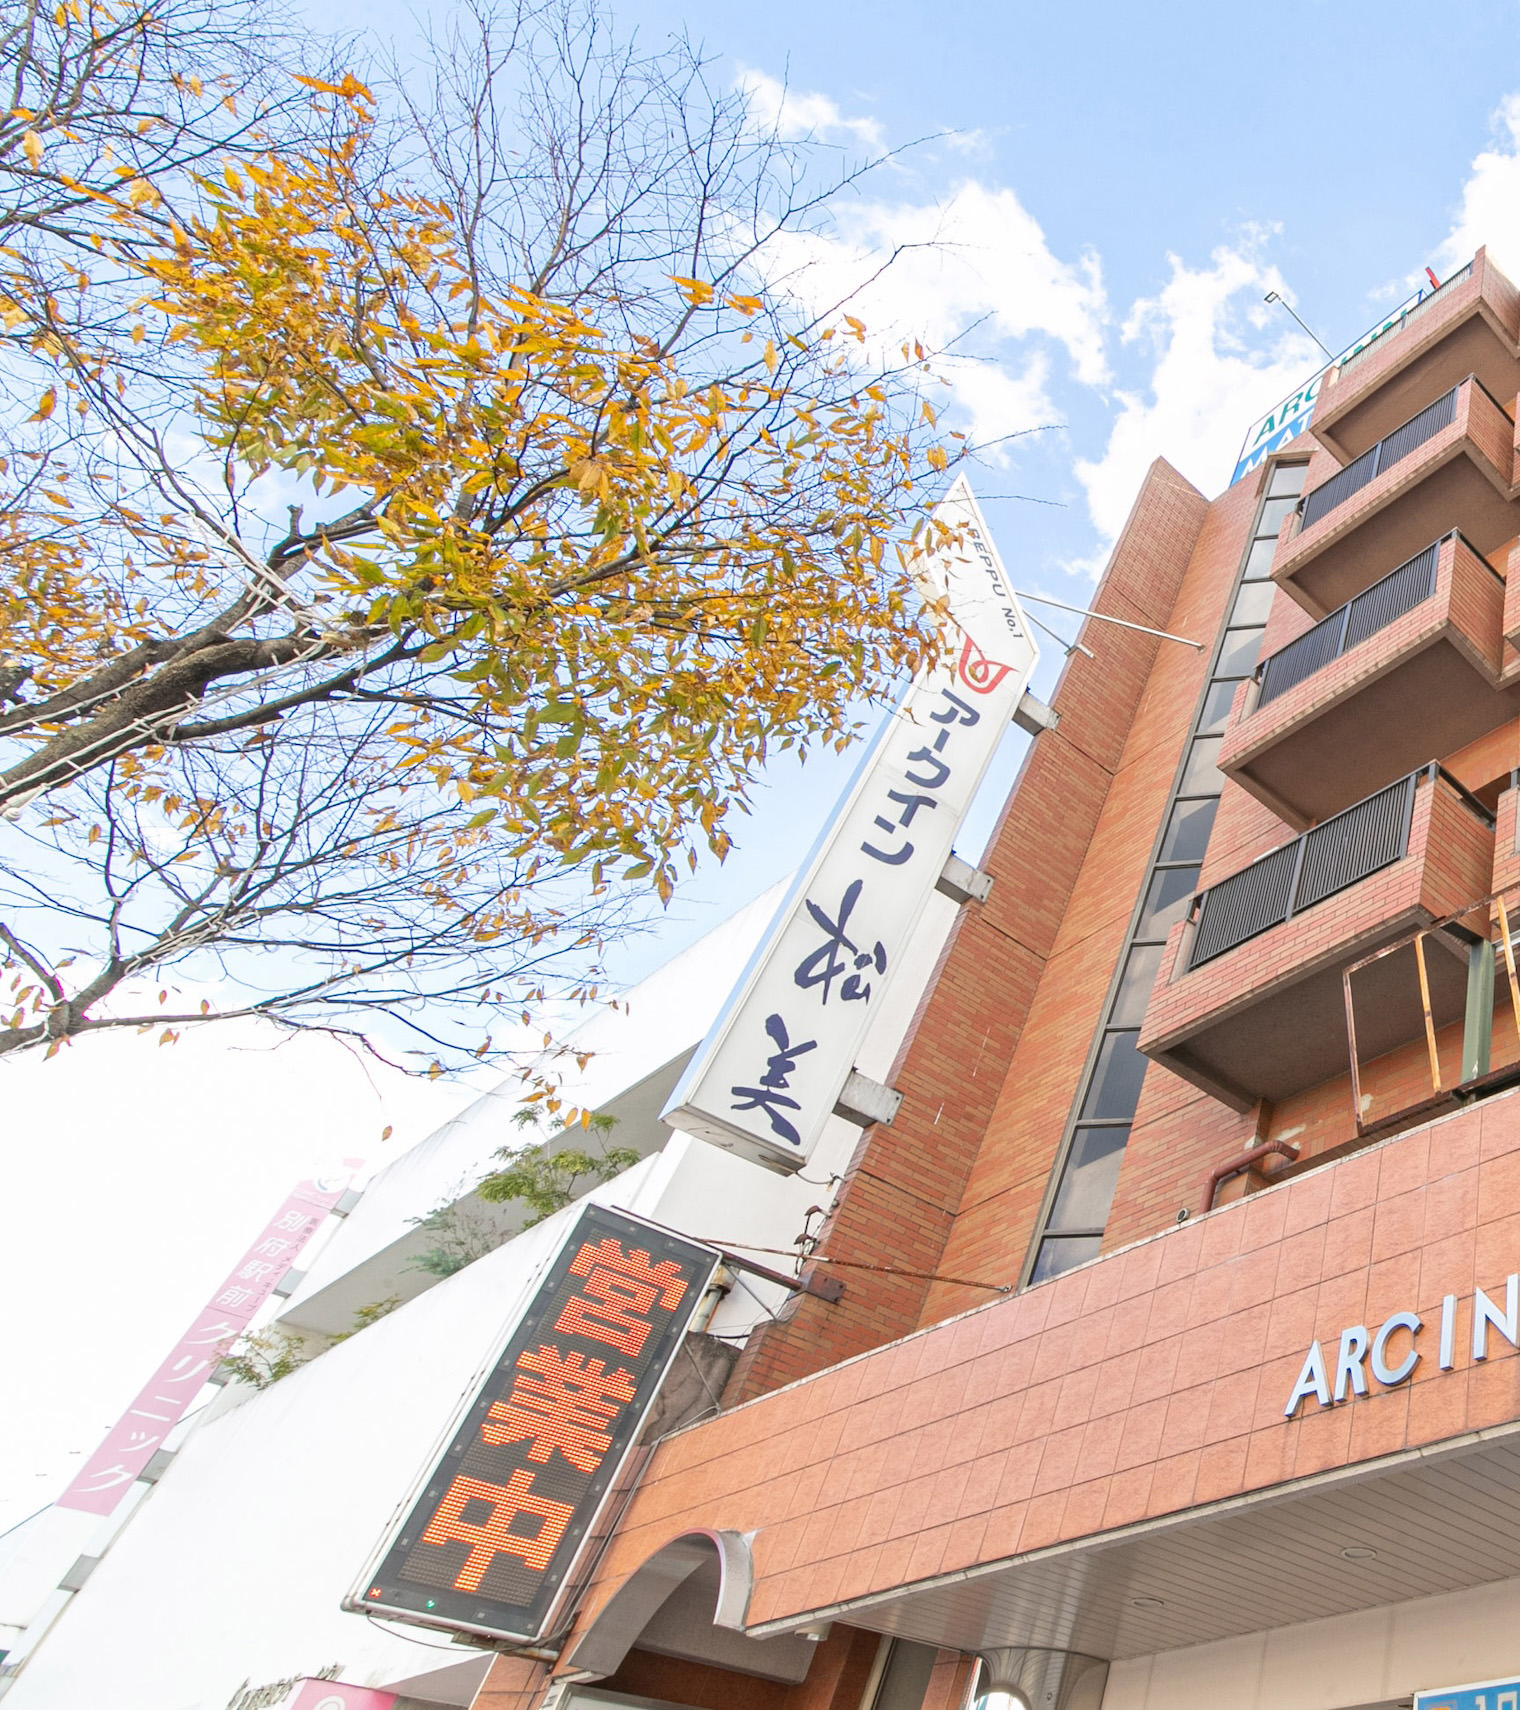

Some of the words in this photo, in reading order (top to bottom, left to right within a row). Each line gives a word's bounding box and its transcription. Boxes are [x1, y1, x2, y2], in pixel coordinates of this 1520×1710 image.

[1002, 608, 1024, 638] No.1
[422, 1238, 689, 1592] 営業中
[1285, 1311, 1423, 1417] ARC
